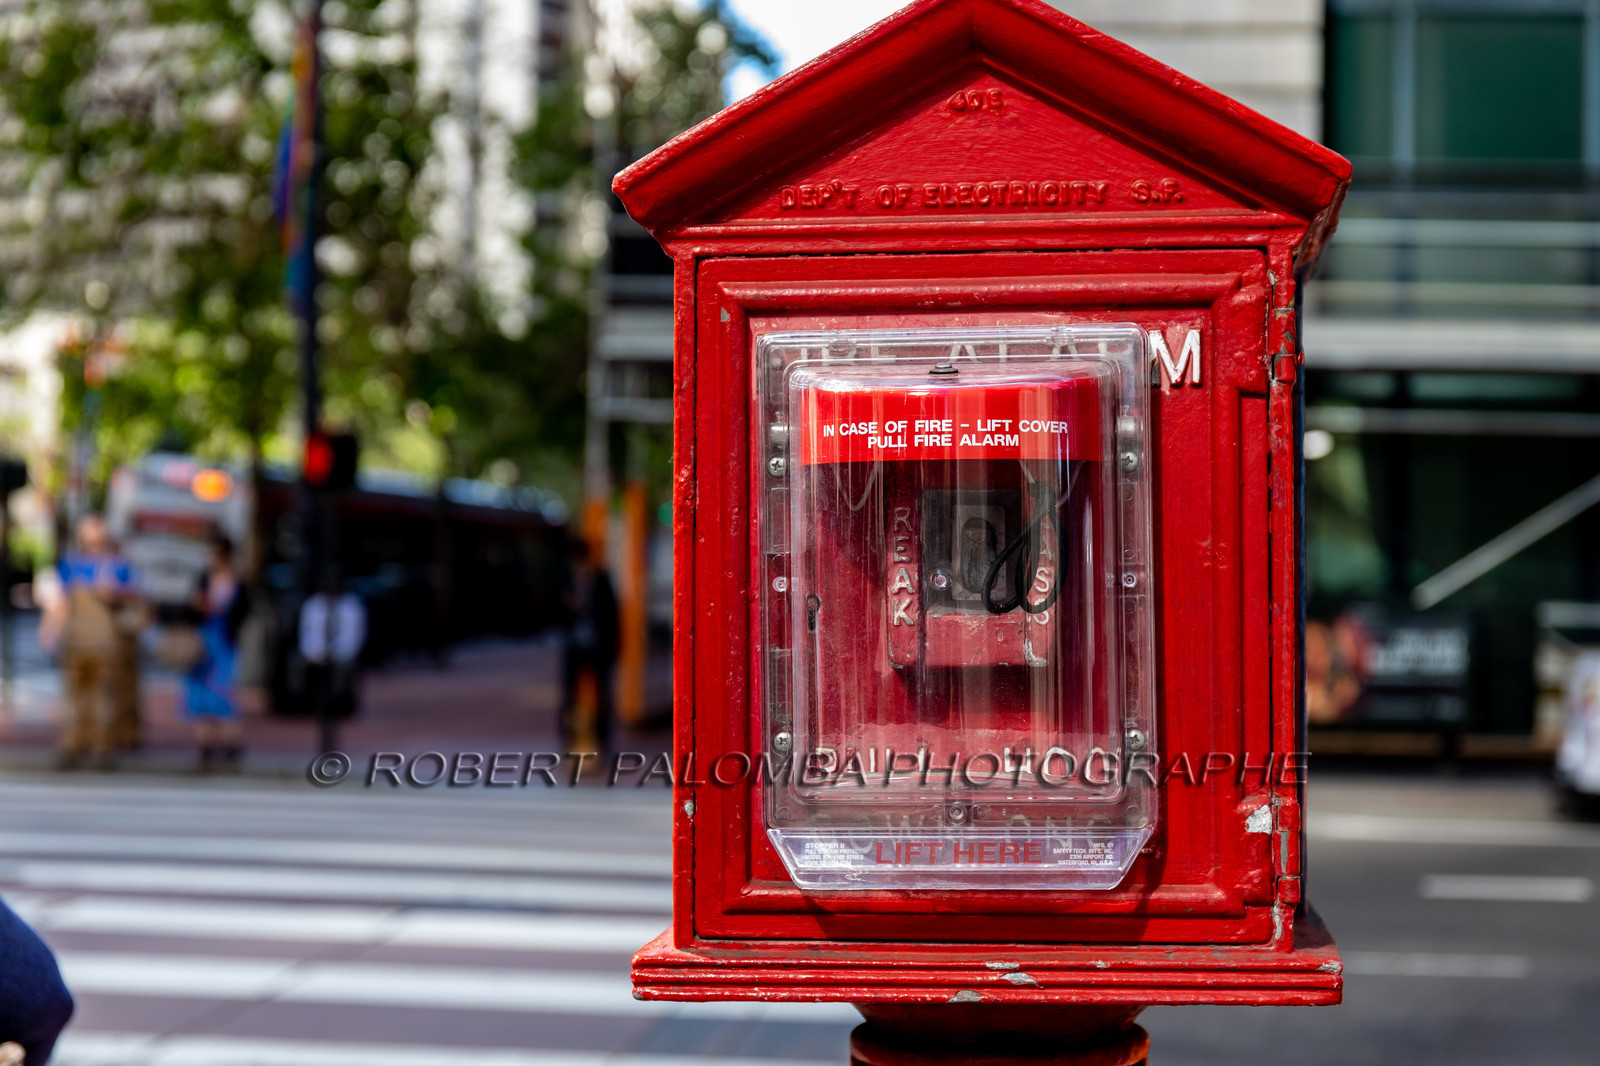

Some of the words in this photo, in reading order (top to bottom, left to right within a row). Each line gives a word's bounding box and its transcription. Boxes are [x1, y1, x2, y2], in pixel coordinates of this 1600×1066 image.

[874, 183, 913, 209] OF
[922, 180, 1110, 208] ELECTRICITY
[1131, 178, 1185, 203] S.F.
[823, 424, 835, 437] IN
[839, 421, 878, 436] CASE
[884, 420, 908, 434] OF
[914, 419, 953, 433] FIRE
[977, 419, 1013, 432] LIFT
[1018, 419, 1069, 434] COVER
[867, 435, 908, 449] PULL
[914, 434, 953, 447] FIRE
[959, 433, 1020, 447] ALARM
[875, 842, 943, 865] LIFT
[953, 842, 1043, 865] HERE
